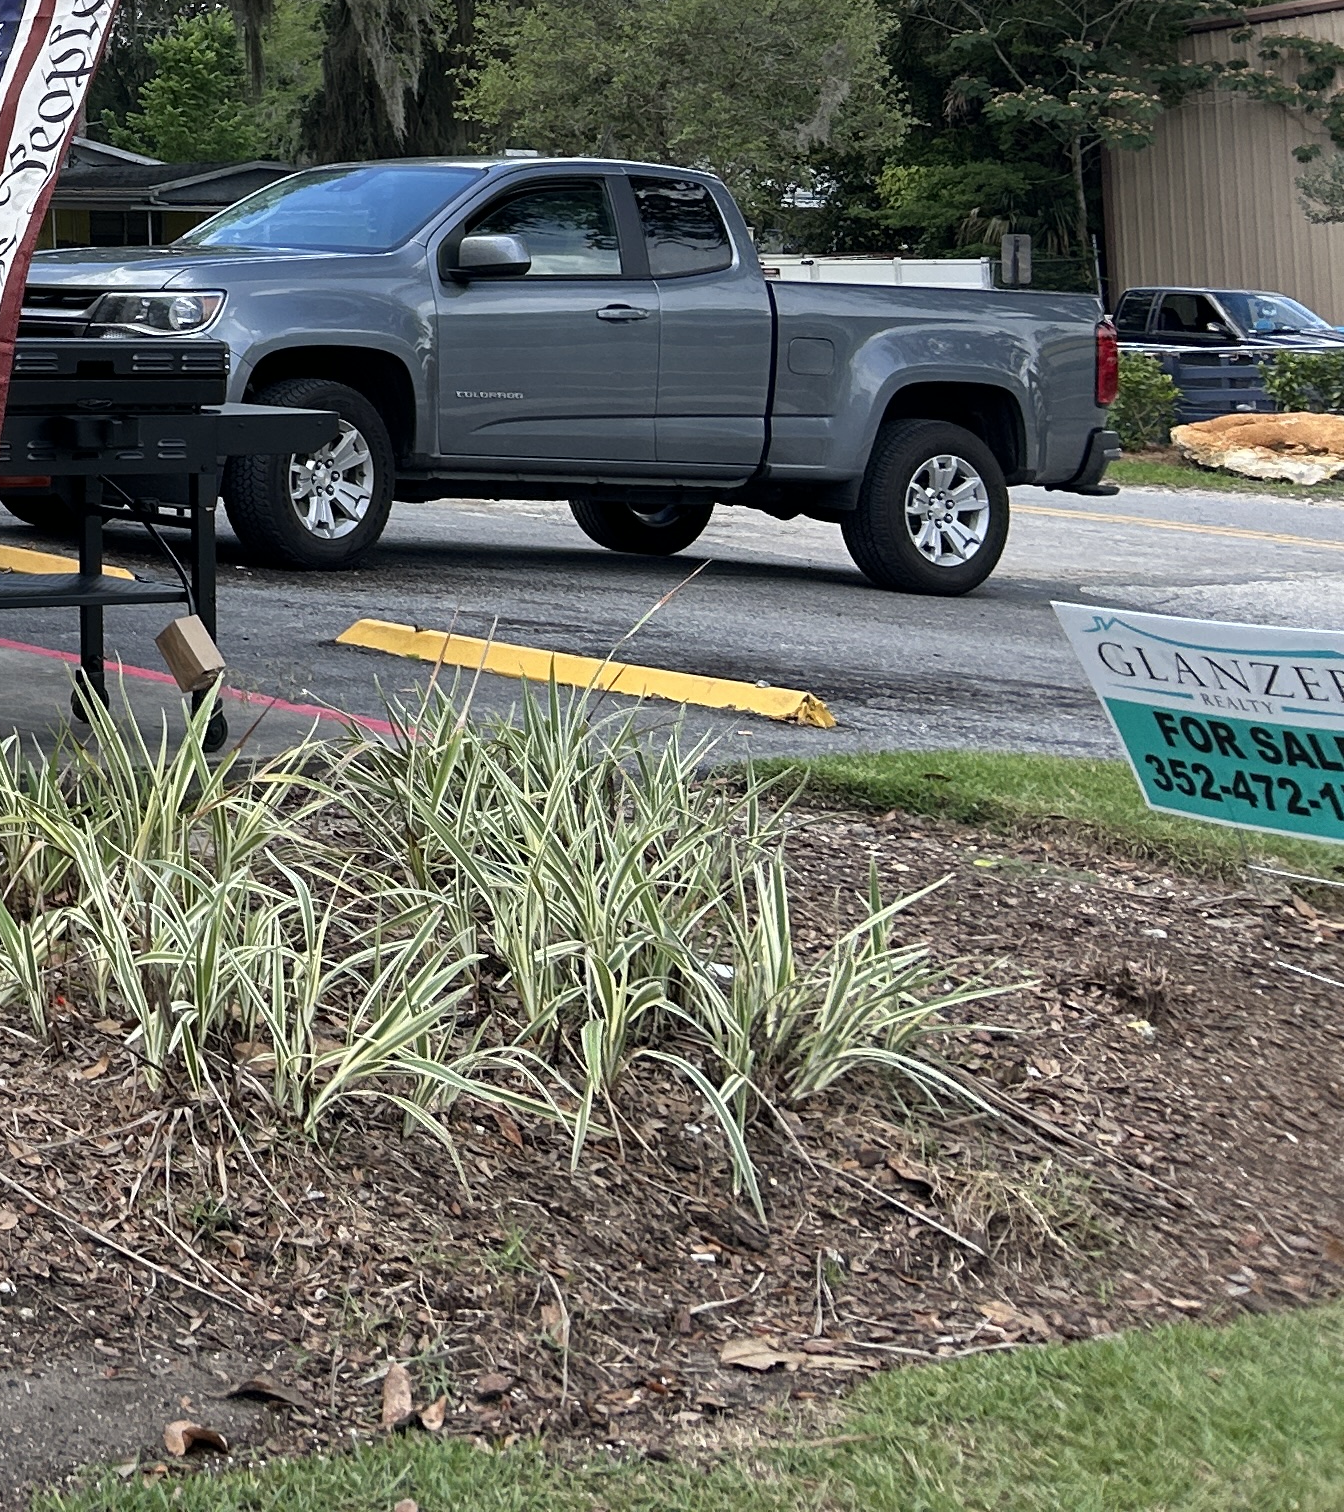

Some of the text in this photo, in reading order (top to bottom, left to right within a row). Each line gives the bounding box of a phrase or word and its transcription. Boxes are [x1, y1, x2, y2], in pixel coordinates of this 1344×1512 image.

[455, 390, 524, 400] COLORADO
[1200, 692, 1275, 715] REALTY
[1153, 710, 1248, 761] FOR
